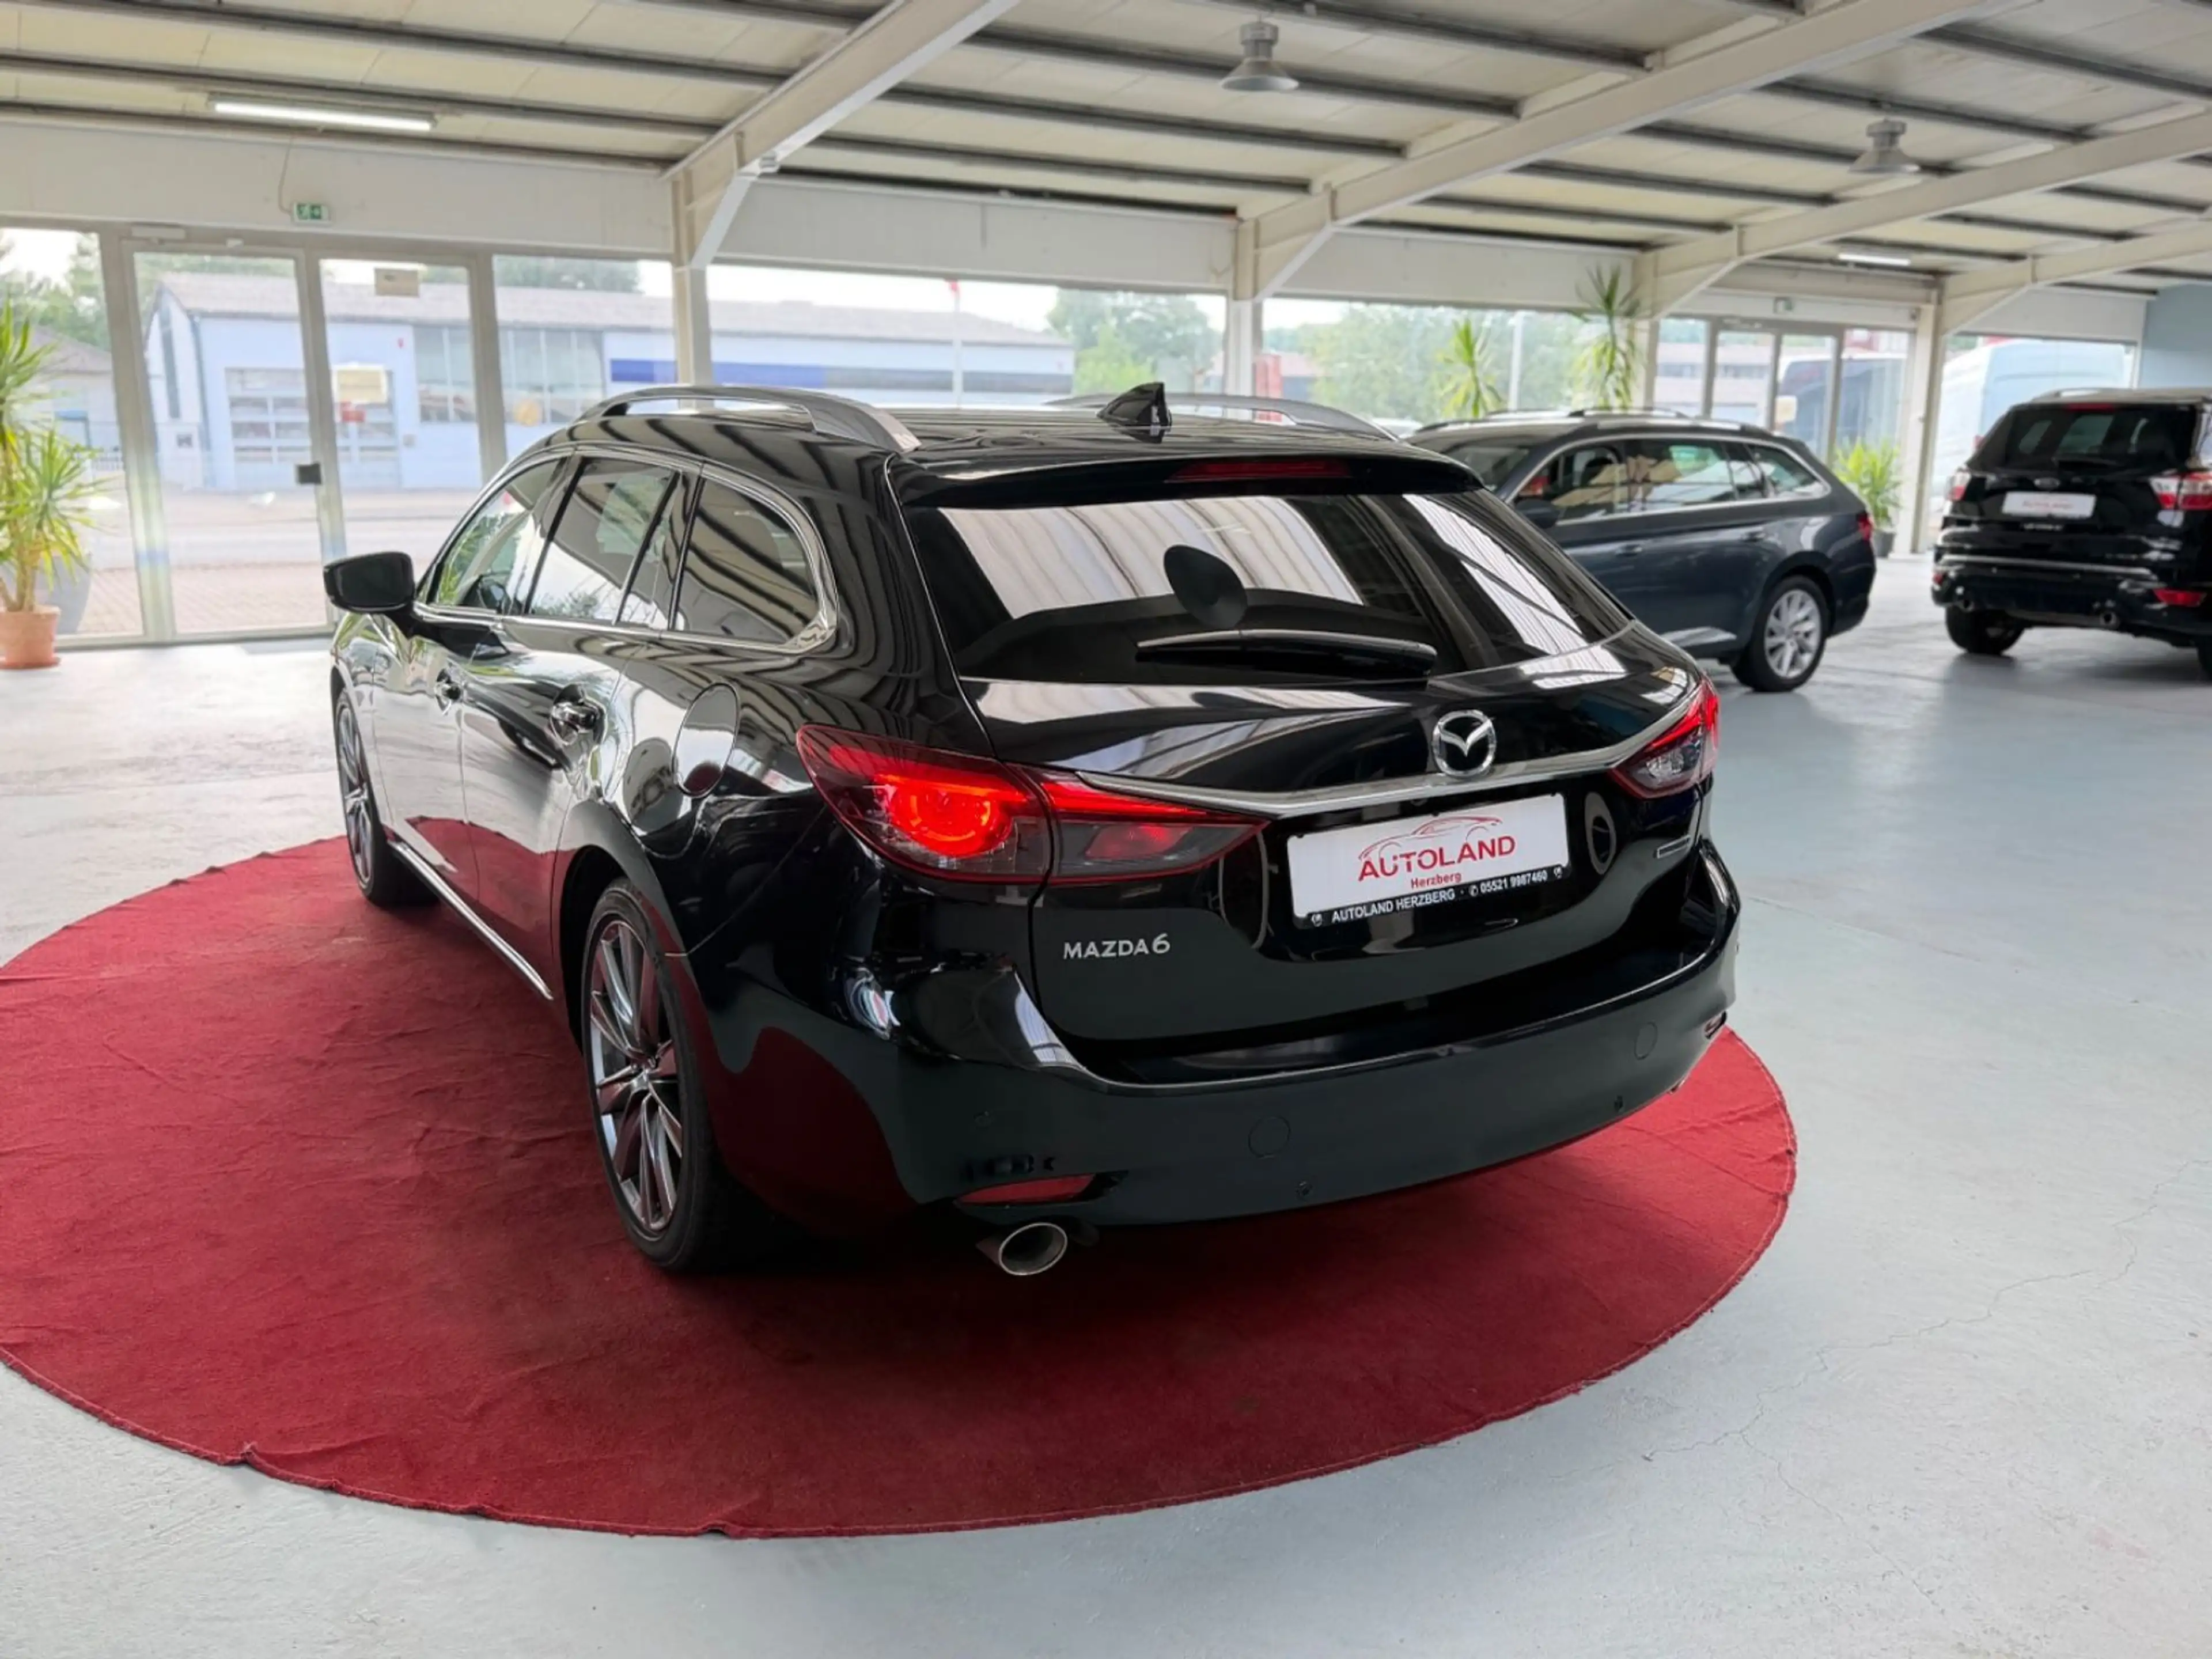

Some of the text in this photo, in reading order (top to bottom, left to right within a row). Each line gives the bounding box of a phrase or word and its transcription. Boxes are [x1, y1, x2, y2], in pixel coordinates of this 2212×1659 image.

[1358, 836, 1516, 881] AUTOLAND
[1411, 872, 1462, 889] Herzberg
[1332, 900, 1393, 923] AUTOLAND
[1395, 888, 1455, 910] HERZBERG
[1480, 878, 1508, 893] 05521
[1063, 933, 1171, 959] MAZDA6
